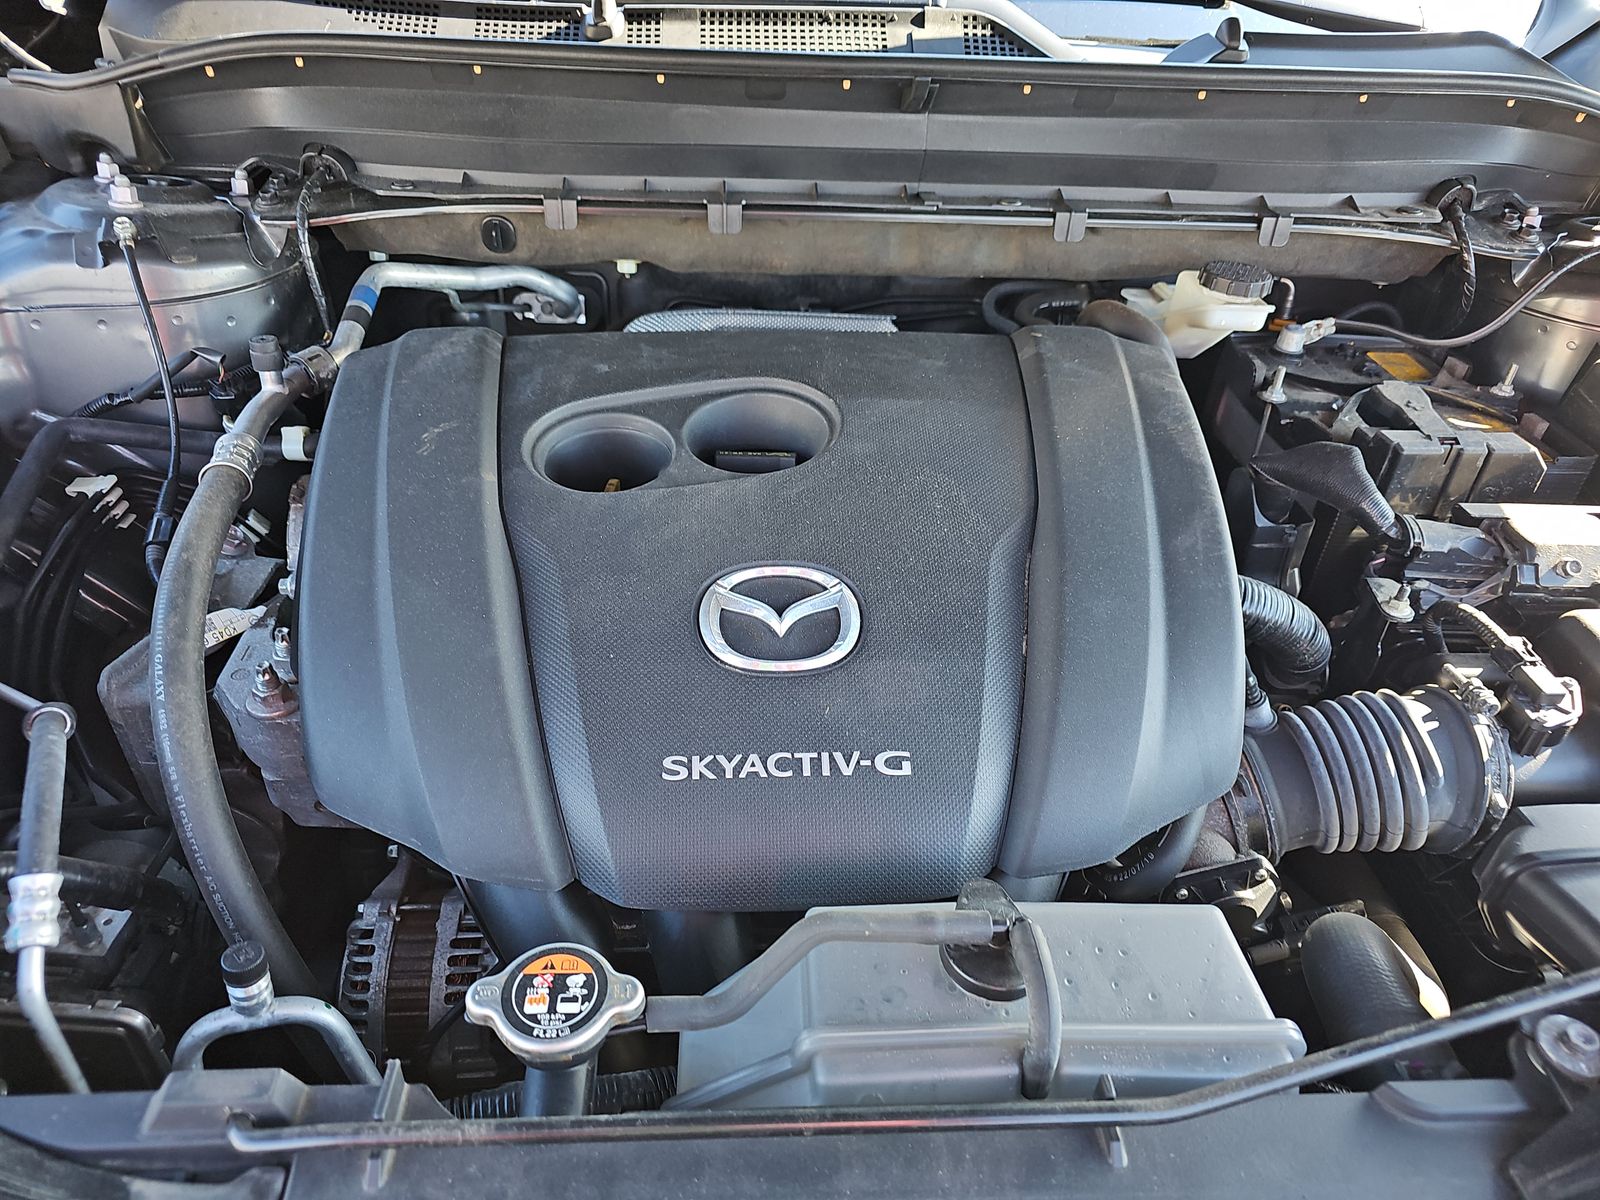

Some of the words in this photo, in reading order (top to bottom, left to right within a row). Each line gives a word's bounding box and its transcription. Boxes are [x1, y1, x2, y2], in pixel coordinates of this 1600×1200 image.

[212, 626, 238, 642] KD45
[661, 750, 912, 782] SKYACTIV-G
[154, 653, 165, 702] GALAXY
[175, 795, 208, 872] Flexbarrier
[204, 875, 217, 891] A/C
[212, 893, 236, 929] SUCTION
[532, 1027, 557, 1038] FL22
